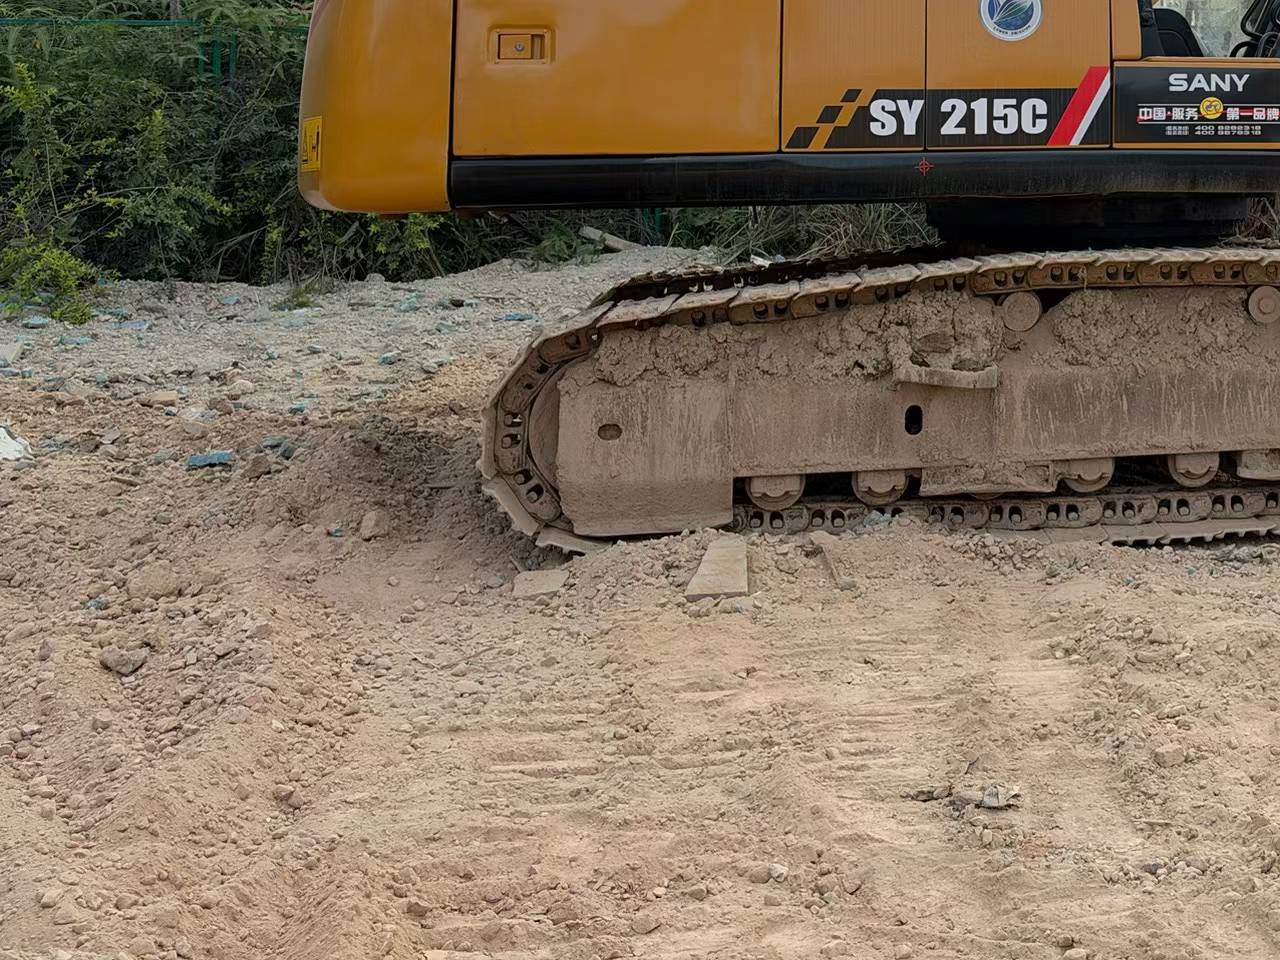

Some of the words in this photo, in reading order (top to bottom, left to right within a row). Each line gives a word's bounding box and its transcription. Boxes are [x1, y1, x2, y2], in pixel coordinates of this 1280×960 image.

[1168, 73, 1250, 92] SANY
[869, 98, 925, 135] SY
[940, 98, 1048, 135] 215C
